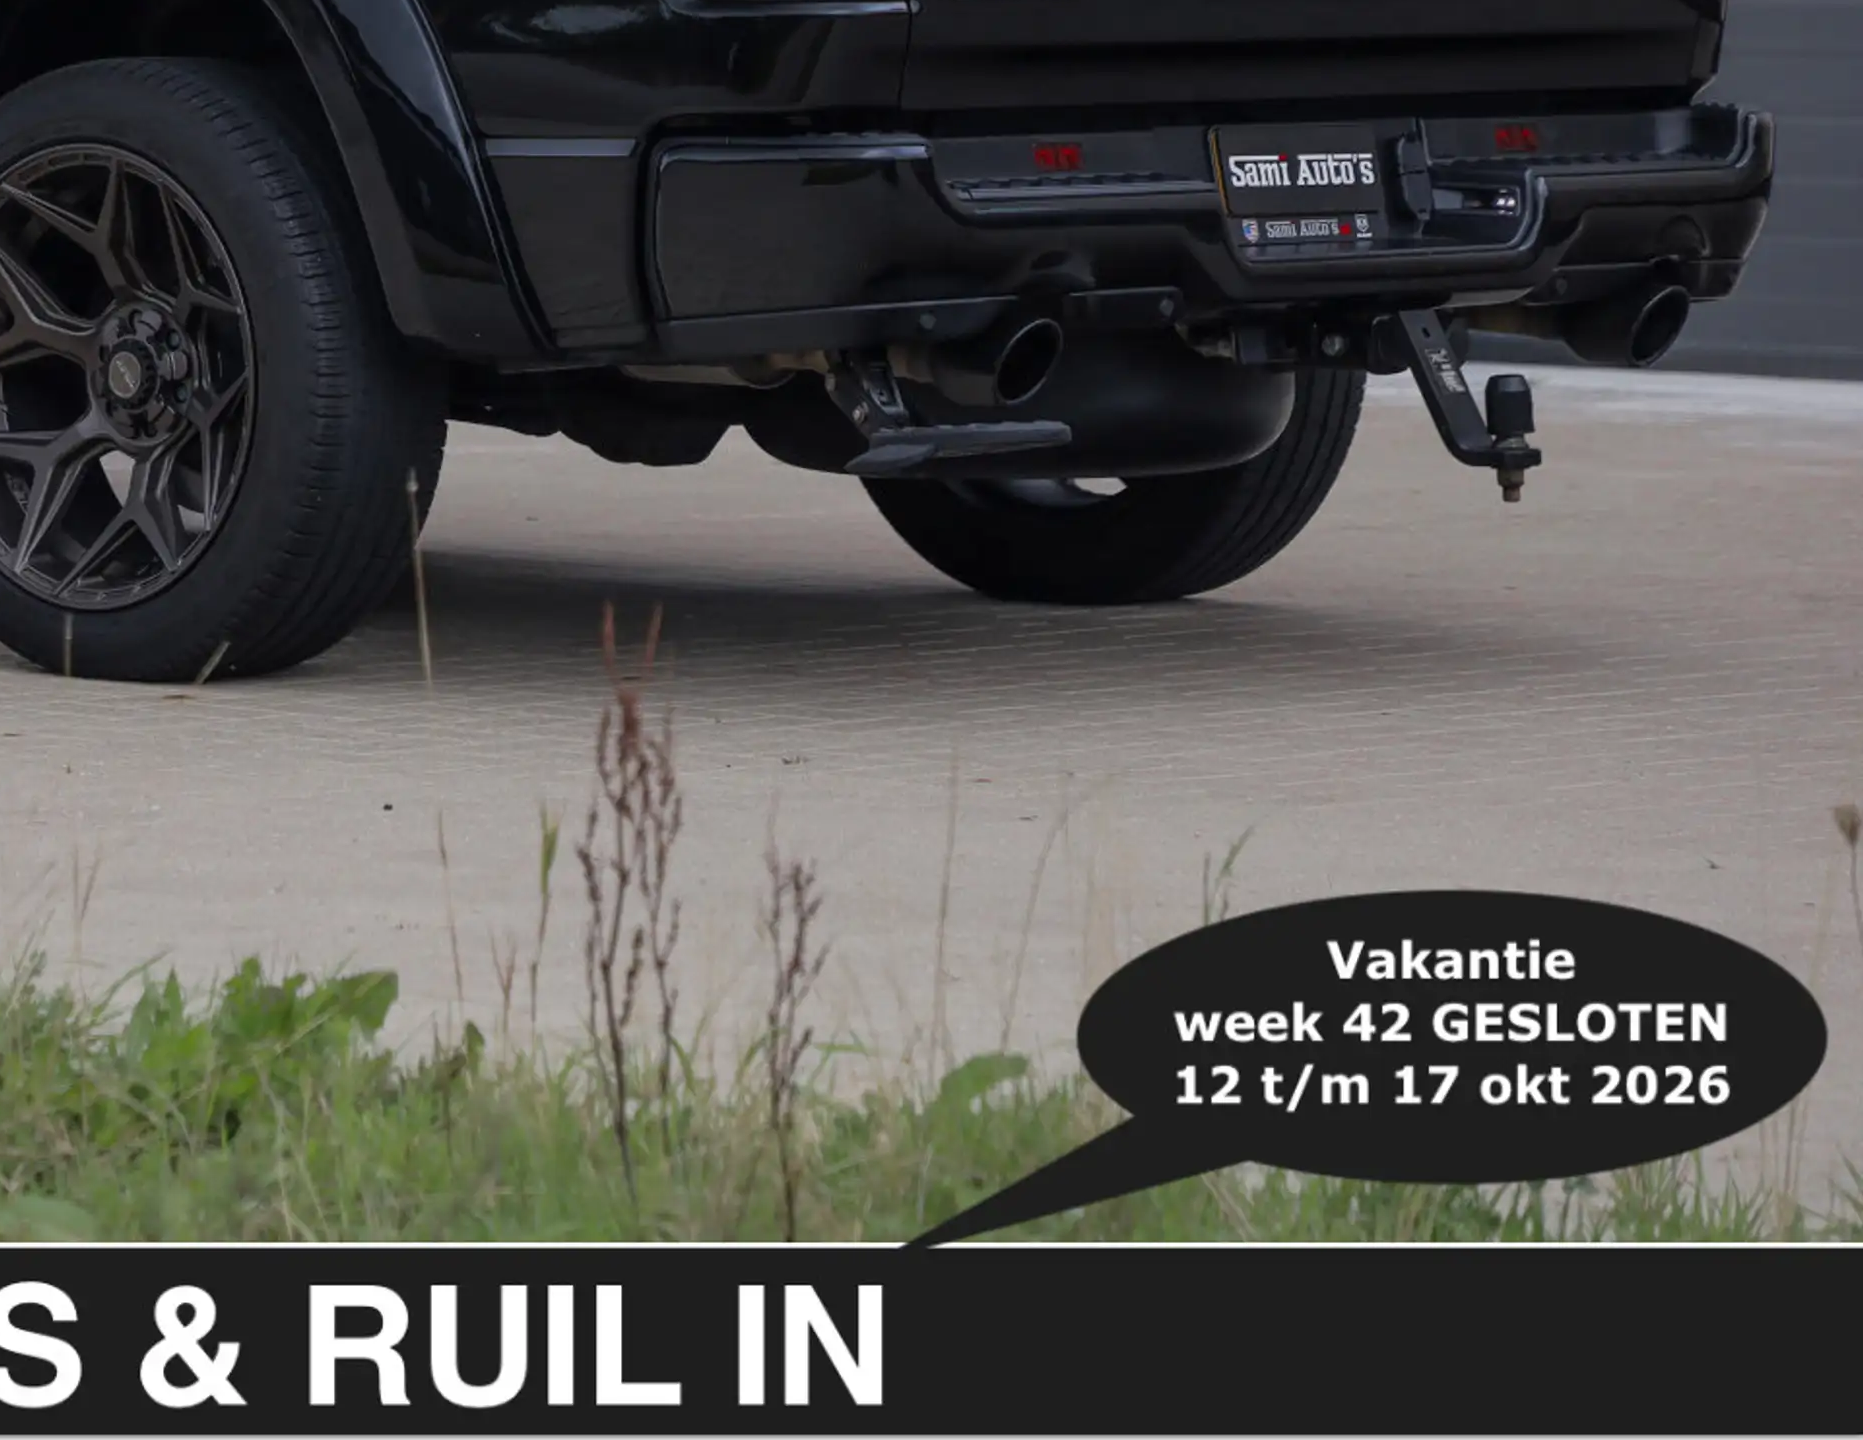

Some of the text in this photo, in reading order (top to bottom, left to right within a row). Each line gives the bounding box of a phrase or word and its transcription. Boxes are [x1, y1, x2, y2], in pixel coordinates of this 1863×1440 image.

[1228, 153, 1375, 187] Sami Auto's
[1264, 220, 1297, 238] Sami
